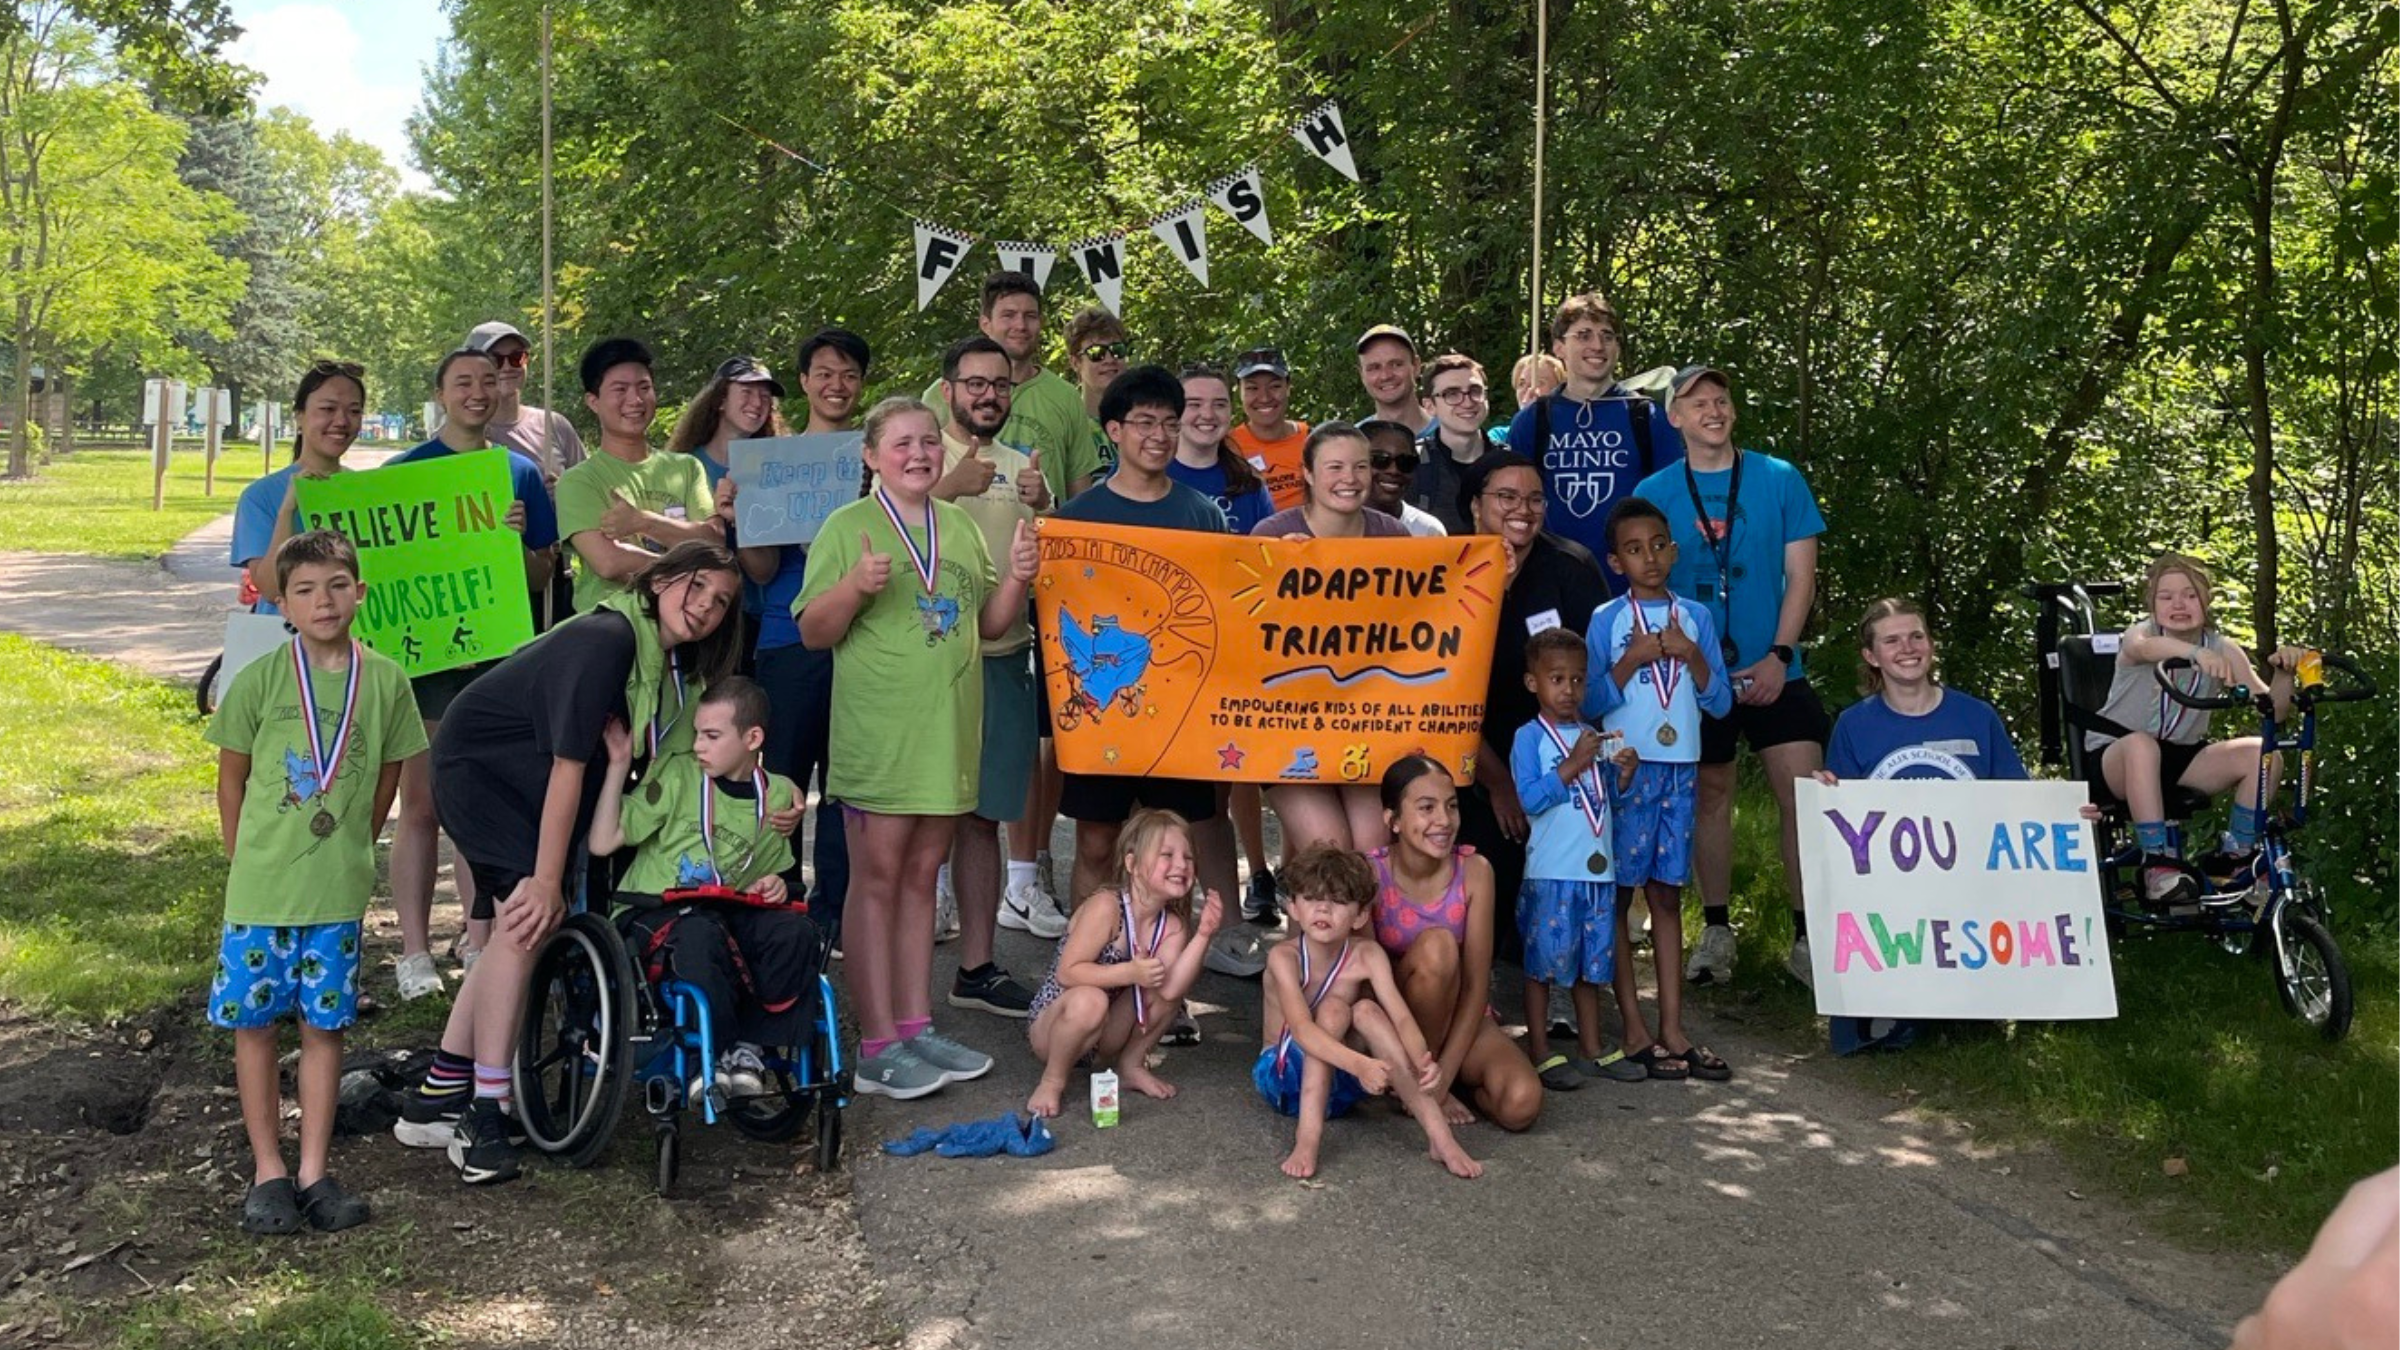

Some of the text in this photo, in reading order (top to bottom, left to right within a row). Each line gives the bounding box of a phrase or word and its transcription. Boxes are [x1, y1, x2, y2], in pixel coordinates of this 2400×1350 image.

[1548, 430, 1622, 450] MAYO
[759, 461, 827, 489] Keep
[1543, 449, 1629, 470] CLINIC
[310, 491, 496, 548] BELIEVE IN
[1277, 564, 1448, 601] ADAPTIVE
[1043, 538, 1077, 559] KIDS
[1111, 543, 1138, 567] FOR
[1142, 552, 1213, 678] CHAMPIONS
[1260, 621, 1461, 658] TRIATHLON
[1220, 697, 1319, 716] EMPOWERING
[1324, 700, 1356, 716] KIDS
[1362, 702, 1381, 717] OF
[1388, 703, 1415, 717] ALL
[1210, 714, 1483, 735] TO BE ACTIVE & CONFIDENT CHAMPIO
[1911, 750, 1952, 767] SCHOOL
[1823, 808, 2088, 875] YOU ARE
[1834, 911, 2095, 973] AWESOME!
